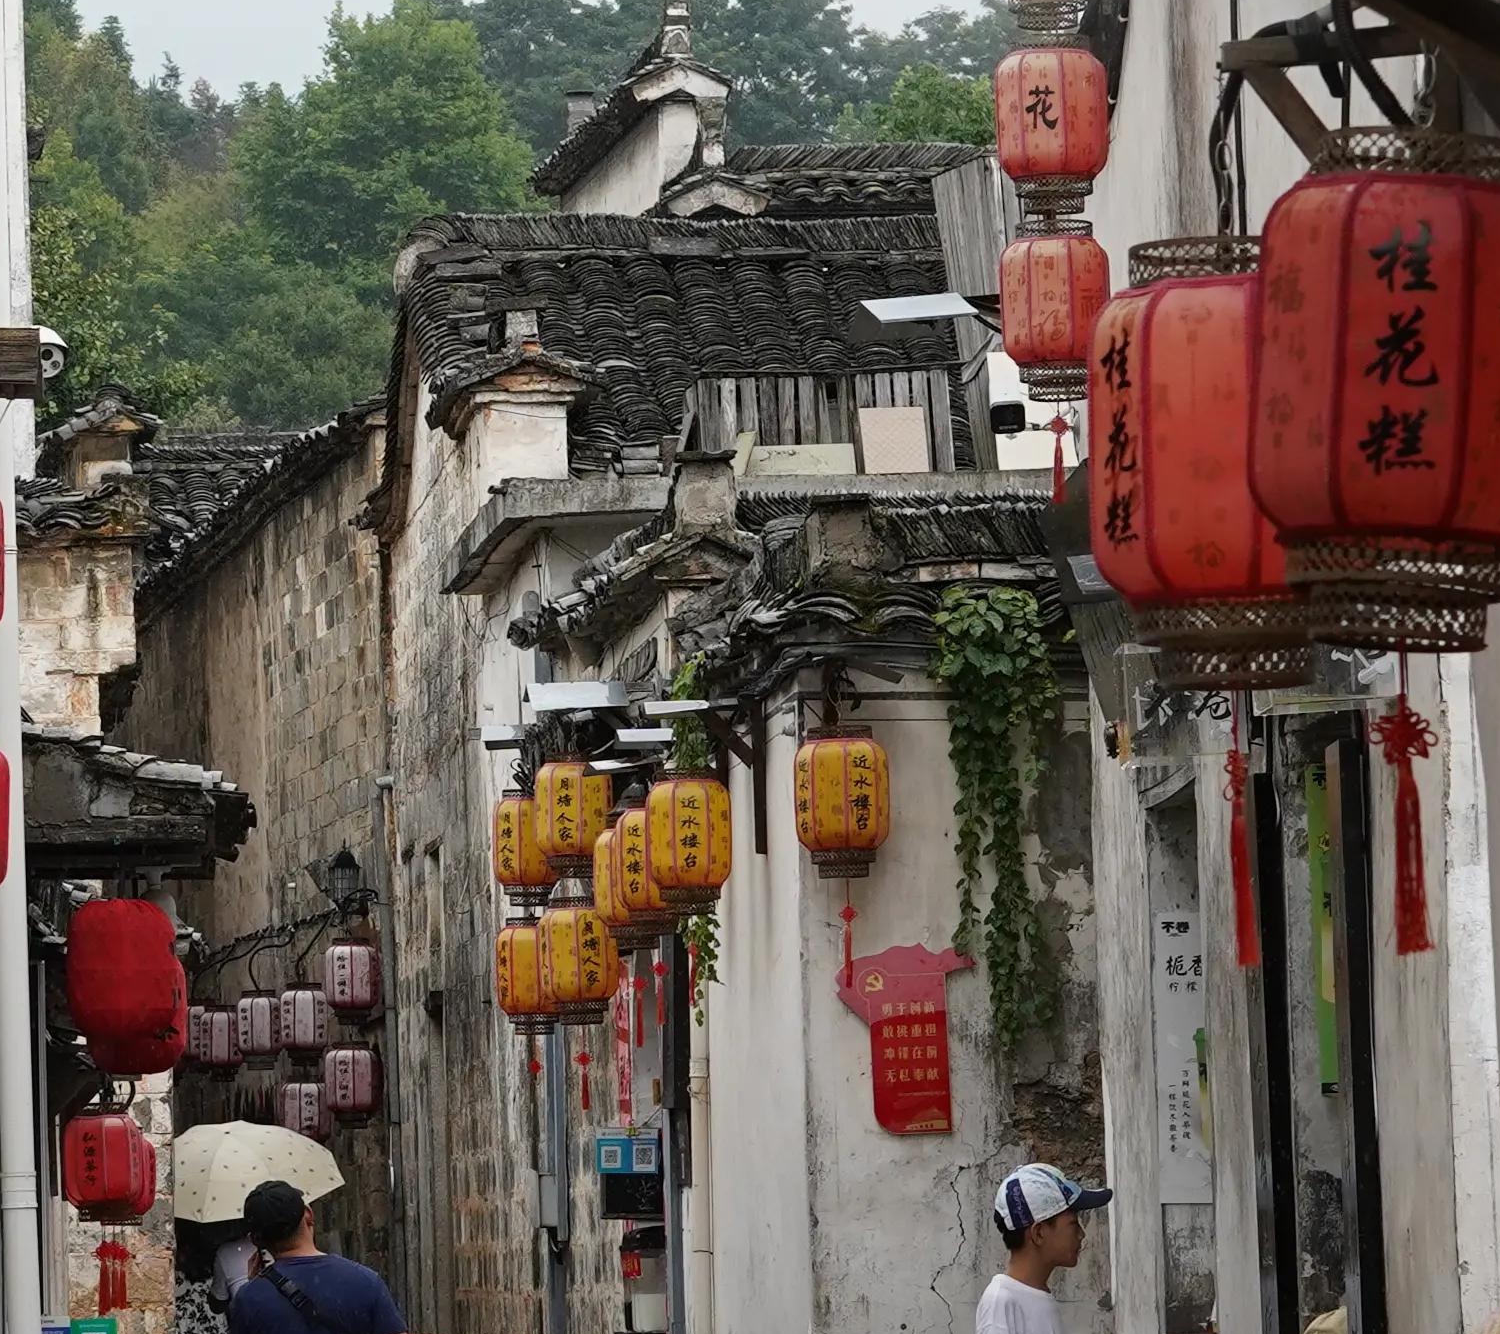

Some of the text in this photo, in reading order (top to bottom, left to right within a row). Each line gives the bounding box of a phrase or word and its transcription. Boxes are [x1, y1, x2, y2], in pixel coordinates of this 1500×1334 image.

[1025, 85, 1059, 130] 花
[1357, 219, 1439, 478] 桂花糕
[1100, 327, 1139, 551] 桂花糕
[555, 777, 574, 842] 月塘人家
[850, 754, 873, 831] 近水楼台
[626, 823, 643, 894] 近水楼台
[679, 795, 701, 870] 近水楼台
[582, 918, 601, 987] 月塘人家
